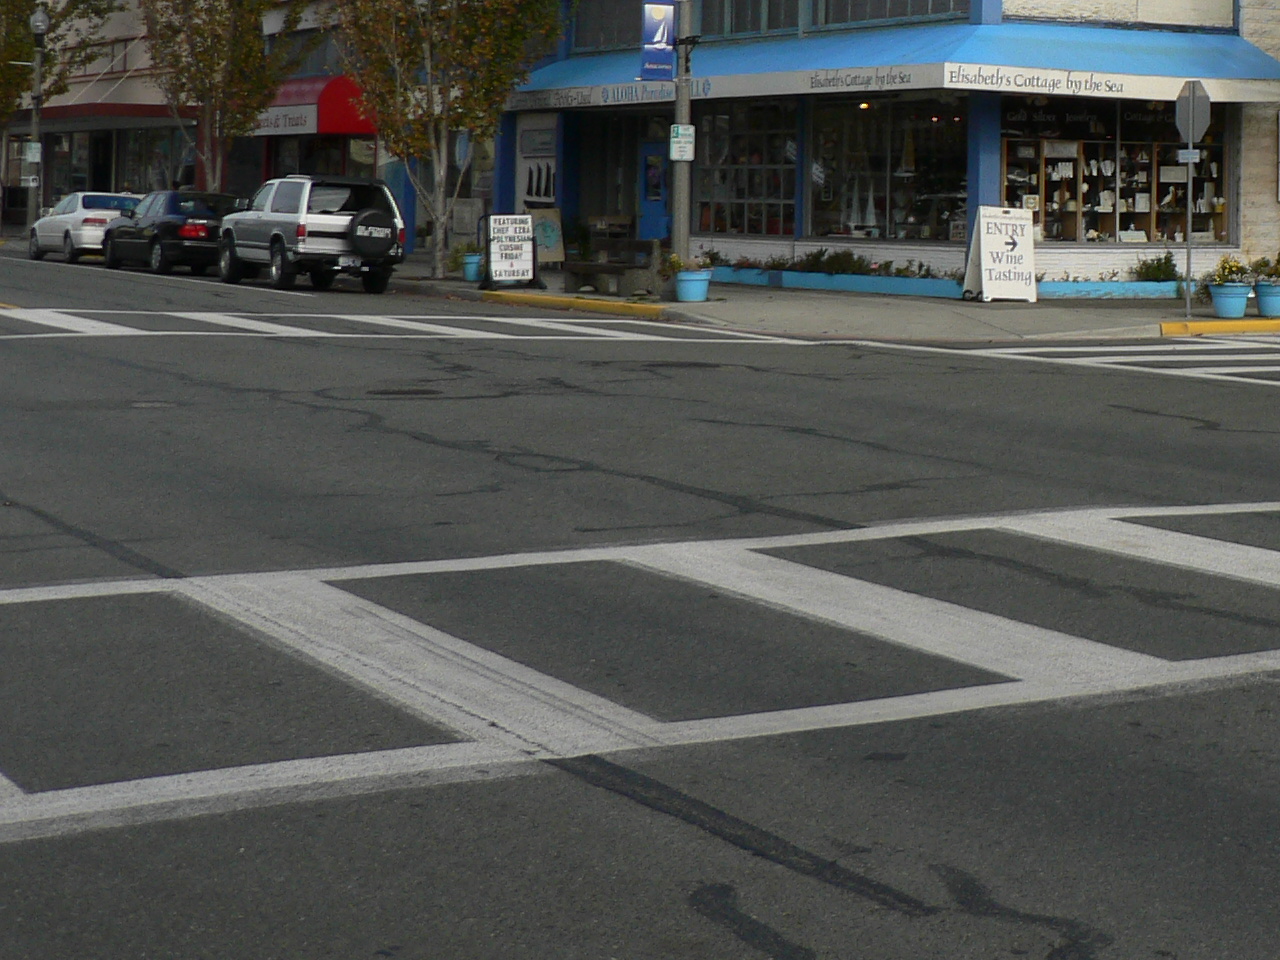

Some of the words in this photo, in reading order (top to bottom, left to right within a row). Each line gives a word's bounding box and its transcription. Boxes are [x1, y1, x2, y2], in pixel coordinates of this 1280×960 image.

[810, 69, 844, 89] Elisabeth's
[845, 73, 873, 89] Cottage
[875, 68, 886, 90] by
[886, 67, 897, 86] the
[898, 71, 912, 84] Sea
[949, 65, 1011, 88] Elisabeth's
[1014, 74, 1061, 93] Cottage
[1066, 71, 1082, 94] by
[1084, 73, 1102, 93] the
[1104, 79, 1124, 93] Sea
[493, 217, 529, 226] FEATURING
[986, 222, 1026, 237] ENTRY
[500, 252, 523, 260] FRIDAY
[989, 249, 1024, 265] Wine
[494, 269, 530, 278] SATURDAY
[984, 266, 1032, 287] Tasting
